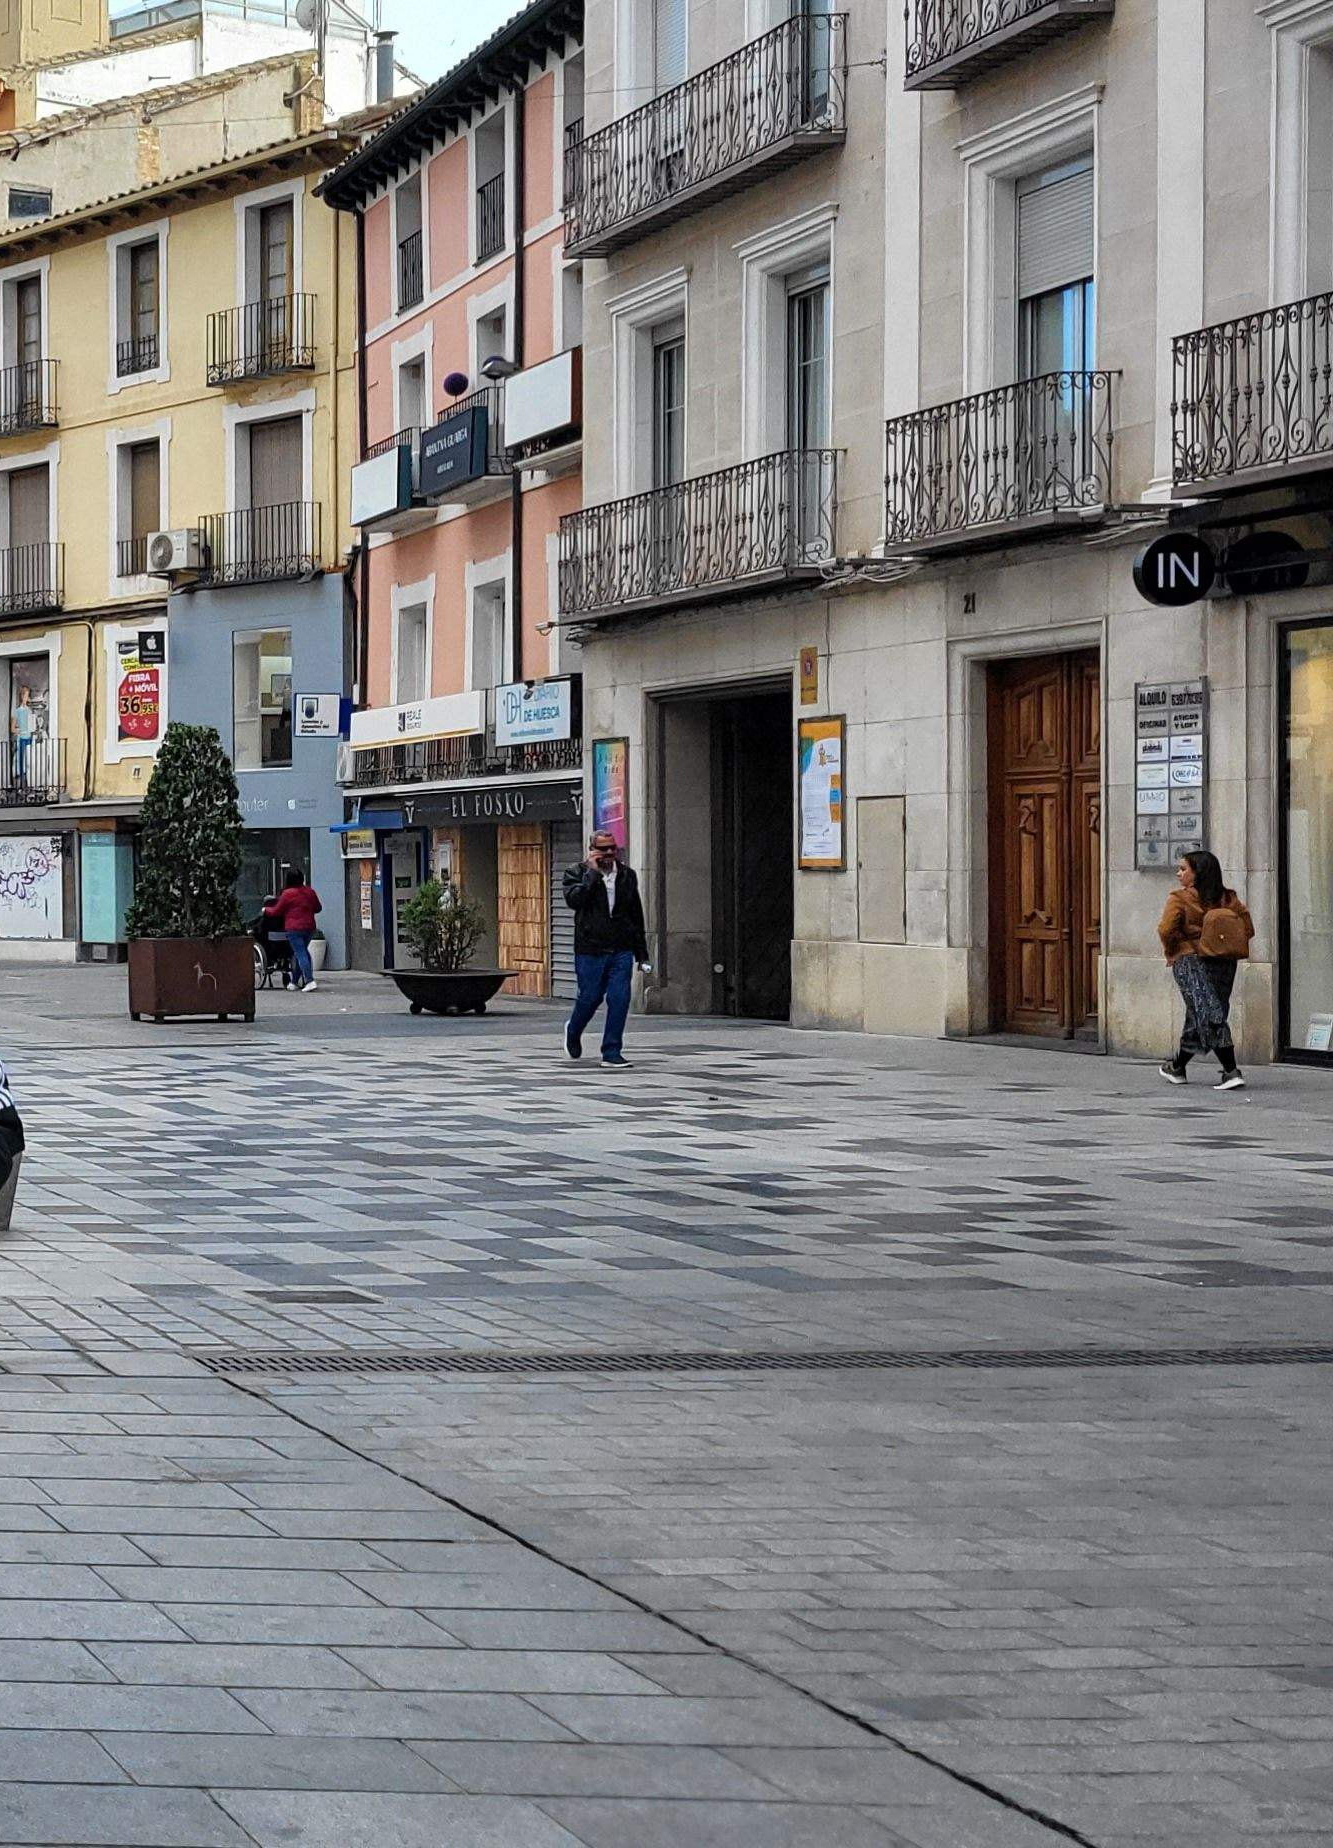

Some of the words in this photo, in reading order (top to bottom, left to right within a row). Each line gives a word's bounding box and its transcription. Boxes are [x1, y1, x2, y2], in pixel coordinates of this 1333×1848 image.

[1157, 551, 1200, 588] IN
[128, 673, 151, 683] FIBRA
[523, 709, 533, 723] DE
[533, 704, 561, 720] HUESCA
[452, 795, 467, 818] EL
[475, 791, 525, 818] FOSKO
